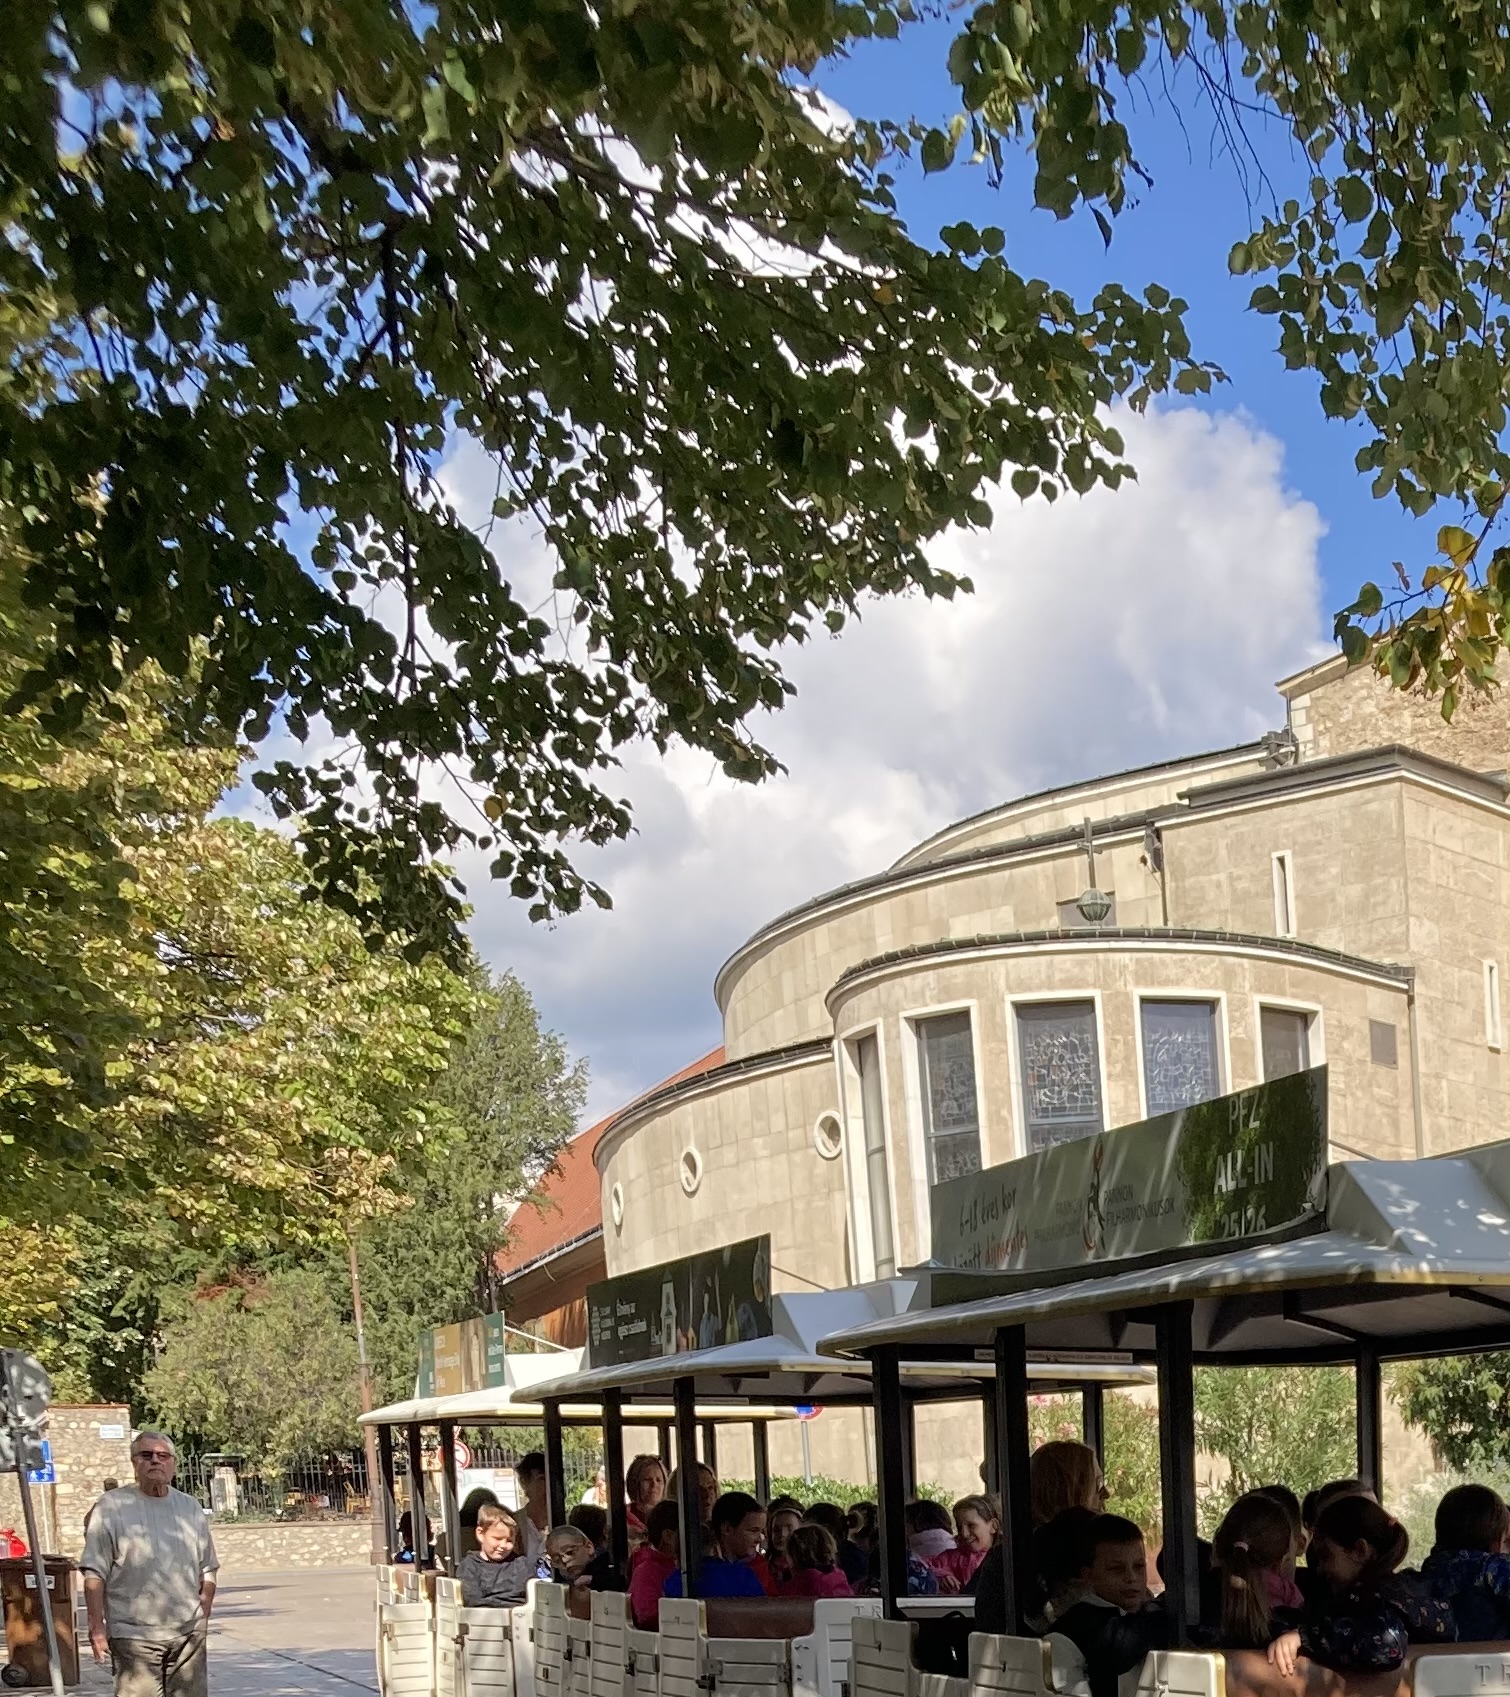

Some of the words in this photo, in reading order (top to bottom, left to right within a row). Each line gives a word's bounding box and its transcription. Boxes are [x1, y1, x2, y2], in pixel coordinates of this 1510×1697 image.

[1213, 1141, 1274, 1195] ALL-IN
[981, 1192, 999, 1225] éves
[1002, 1183, 1016, 1214] kor
[1104, 1184, 1134, 1205] PANNON
